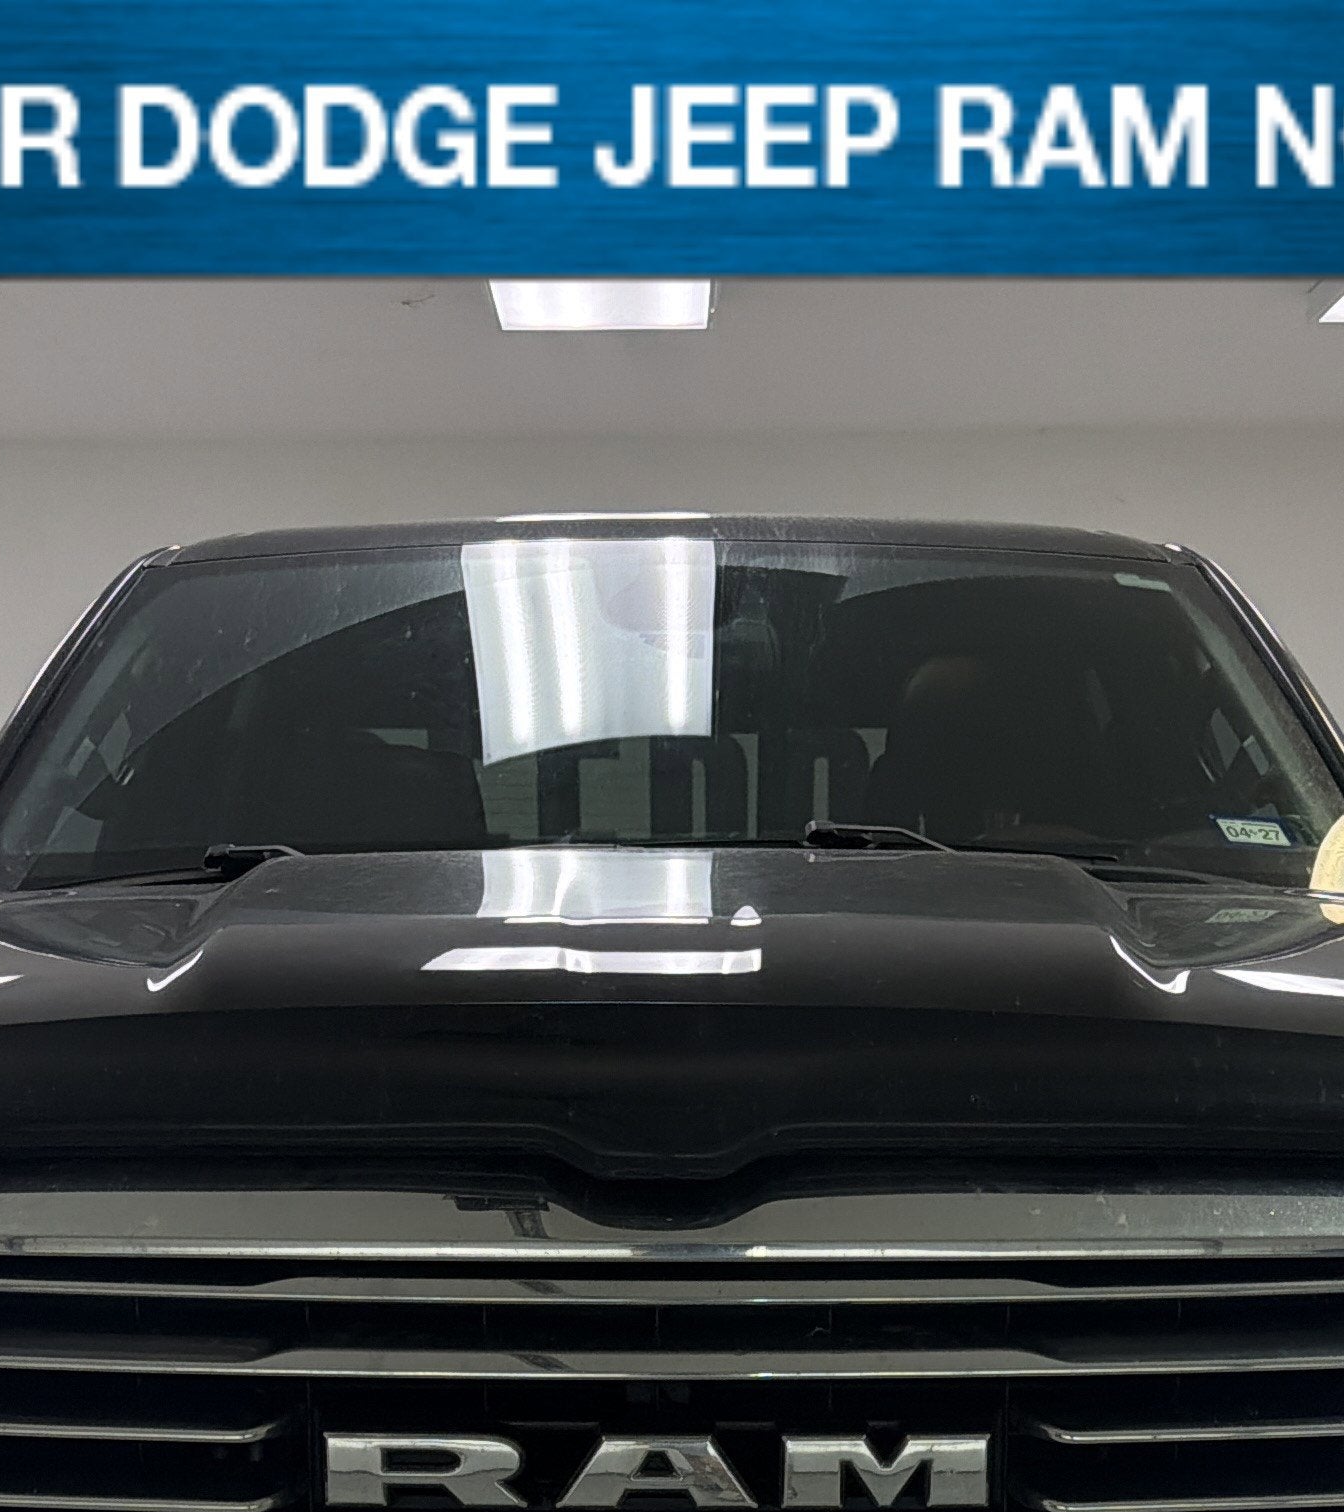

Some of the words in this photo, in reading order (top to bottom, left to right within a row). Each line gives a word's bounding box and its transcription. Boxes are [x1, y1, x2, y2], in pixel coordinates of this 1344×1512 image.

[1225, 825, 1251, 839] 04
[1257, 828, 1280, 841] 27
[323, 1431, 991, 1507] RAM
